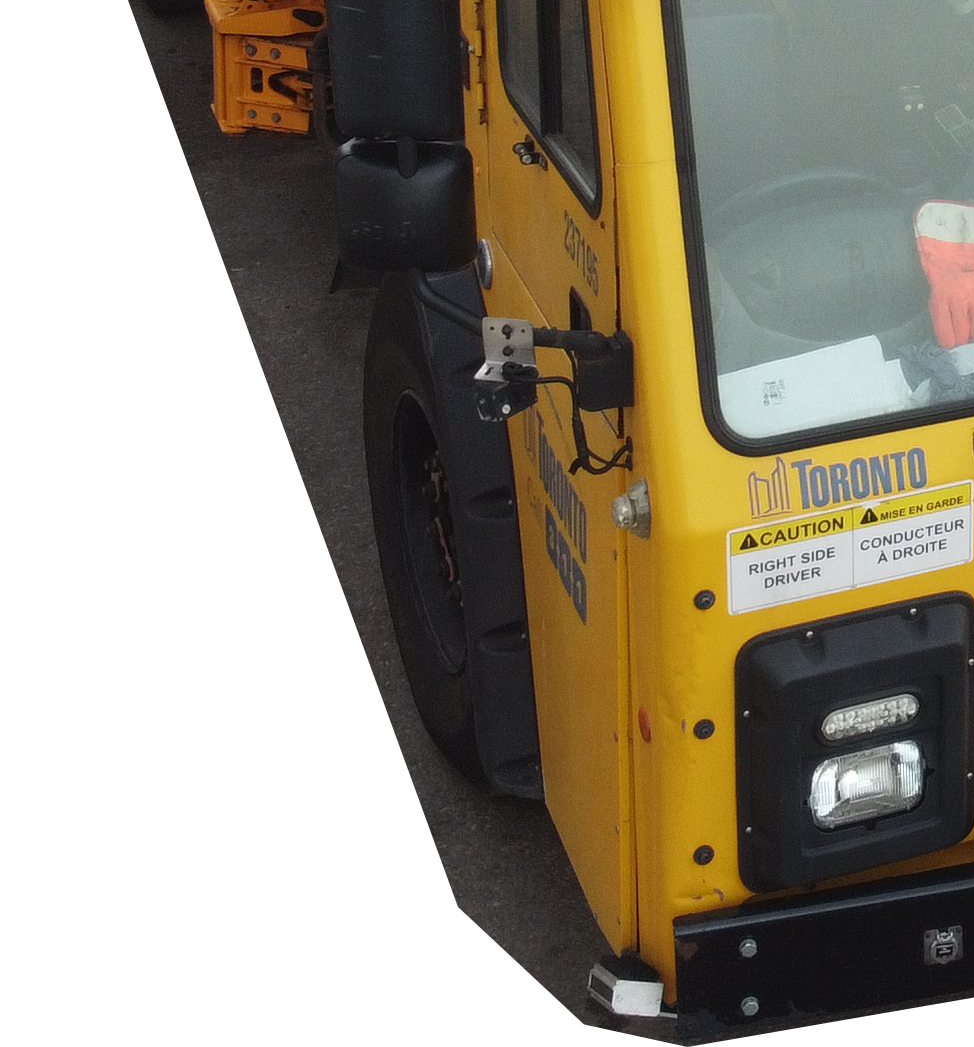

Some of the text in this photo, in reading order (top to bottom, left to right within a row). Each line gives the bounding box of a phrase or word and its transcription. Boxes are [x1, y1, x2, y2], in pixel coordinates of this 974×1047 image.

[791, 447, 928, 511] TORONTO
[880, 495, 964, 522] MISE EN GARDE
[760, 516, 845, 547] CAUTION
[859, 518, 965, 552] CONDUCTEUR
[748, 546, 836, 576] RIGHT SIDE
[877, 538, 948, 565] À DROITE
[764, 566, 822, 590] DRIVER
